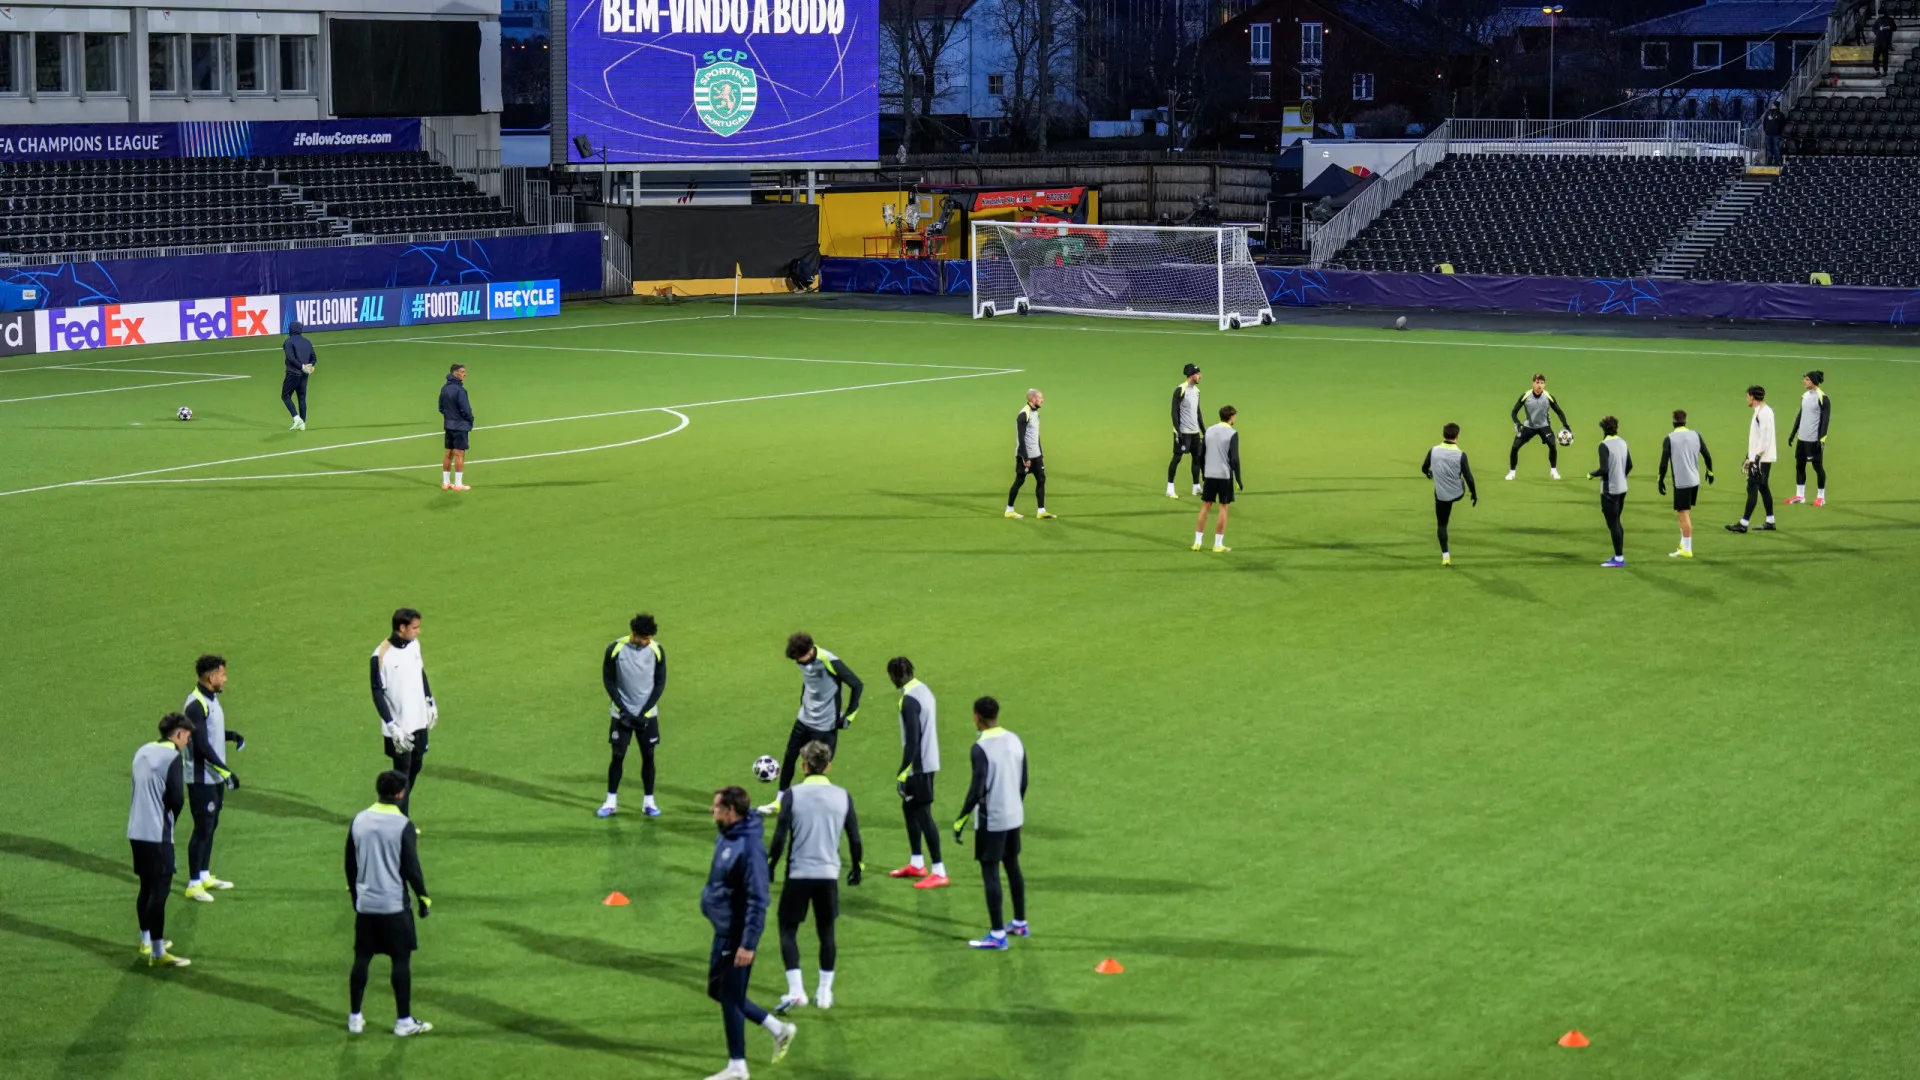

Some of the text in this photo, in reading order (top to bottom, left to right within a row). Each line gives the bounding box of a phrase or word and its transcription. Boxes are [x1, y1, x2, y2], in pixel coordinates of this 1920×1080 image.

[603, 0, 748, 34] BEM-VINDO
[773, 0, 846, 34] BODØ
[703, 48, 748, 65] SCP
[700, 67, 750, 86] SPORTING
[703, 114, 749, 127] PORTUGAL
[18, 136, 103, 153] CHAMPIONS
[107, 135, 160, 151] LEAGUE
[296, 295, 385, 326] WELCOME ALL
[411, 290, 481, 319] #FOOTBALL
[494, 288, 555, 309] RECYCLE
[50, 304, 146, 351] FedEx
[180, 296, 269, 340] FedEx
